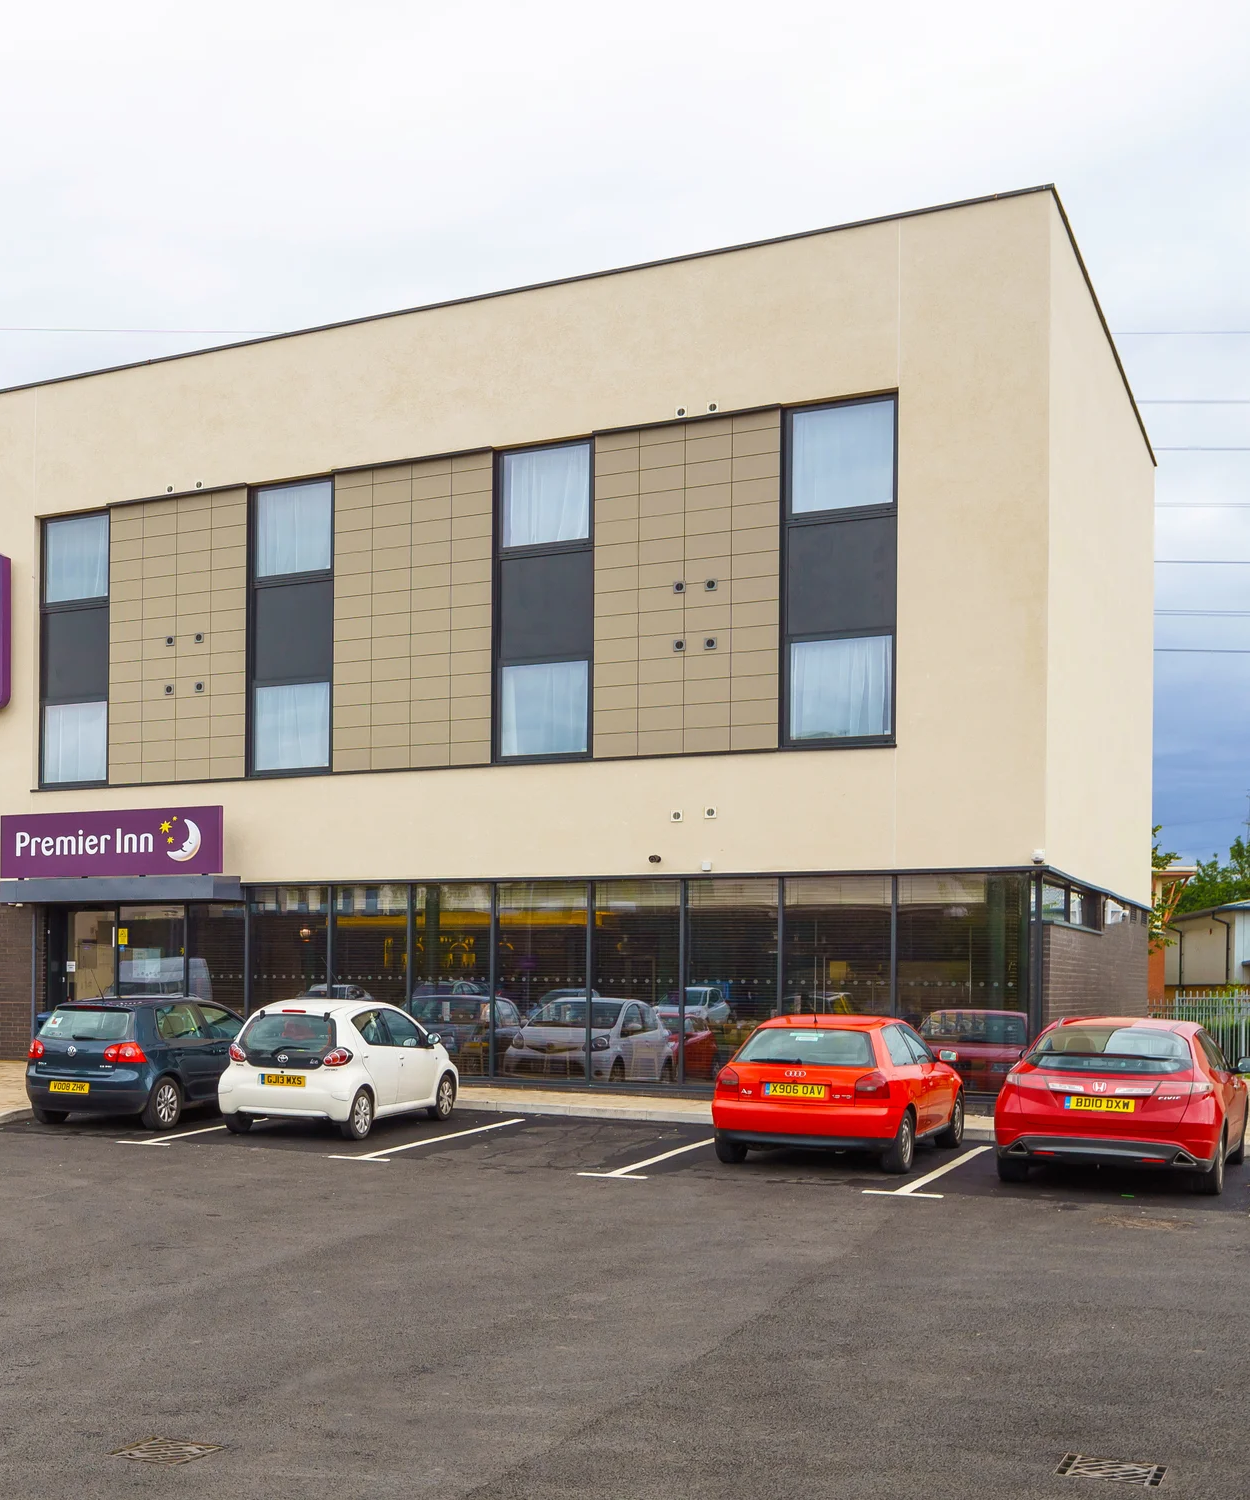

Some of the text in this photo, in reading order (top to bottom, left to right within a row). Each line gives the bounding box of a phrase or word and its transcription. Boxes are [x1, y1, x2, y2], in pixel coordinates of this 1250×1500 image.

[15, 828, 154, 857] Premier Inn
[267, 1075, 302, 1085] GJ13 MXS
[71, 1083, 85, 1092] ZHK
[771, 1084, 823, 1096] X906 OAV
[1075, 1097, 1130, 1110] BD10 DXW
